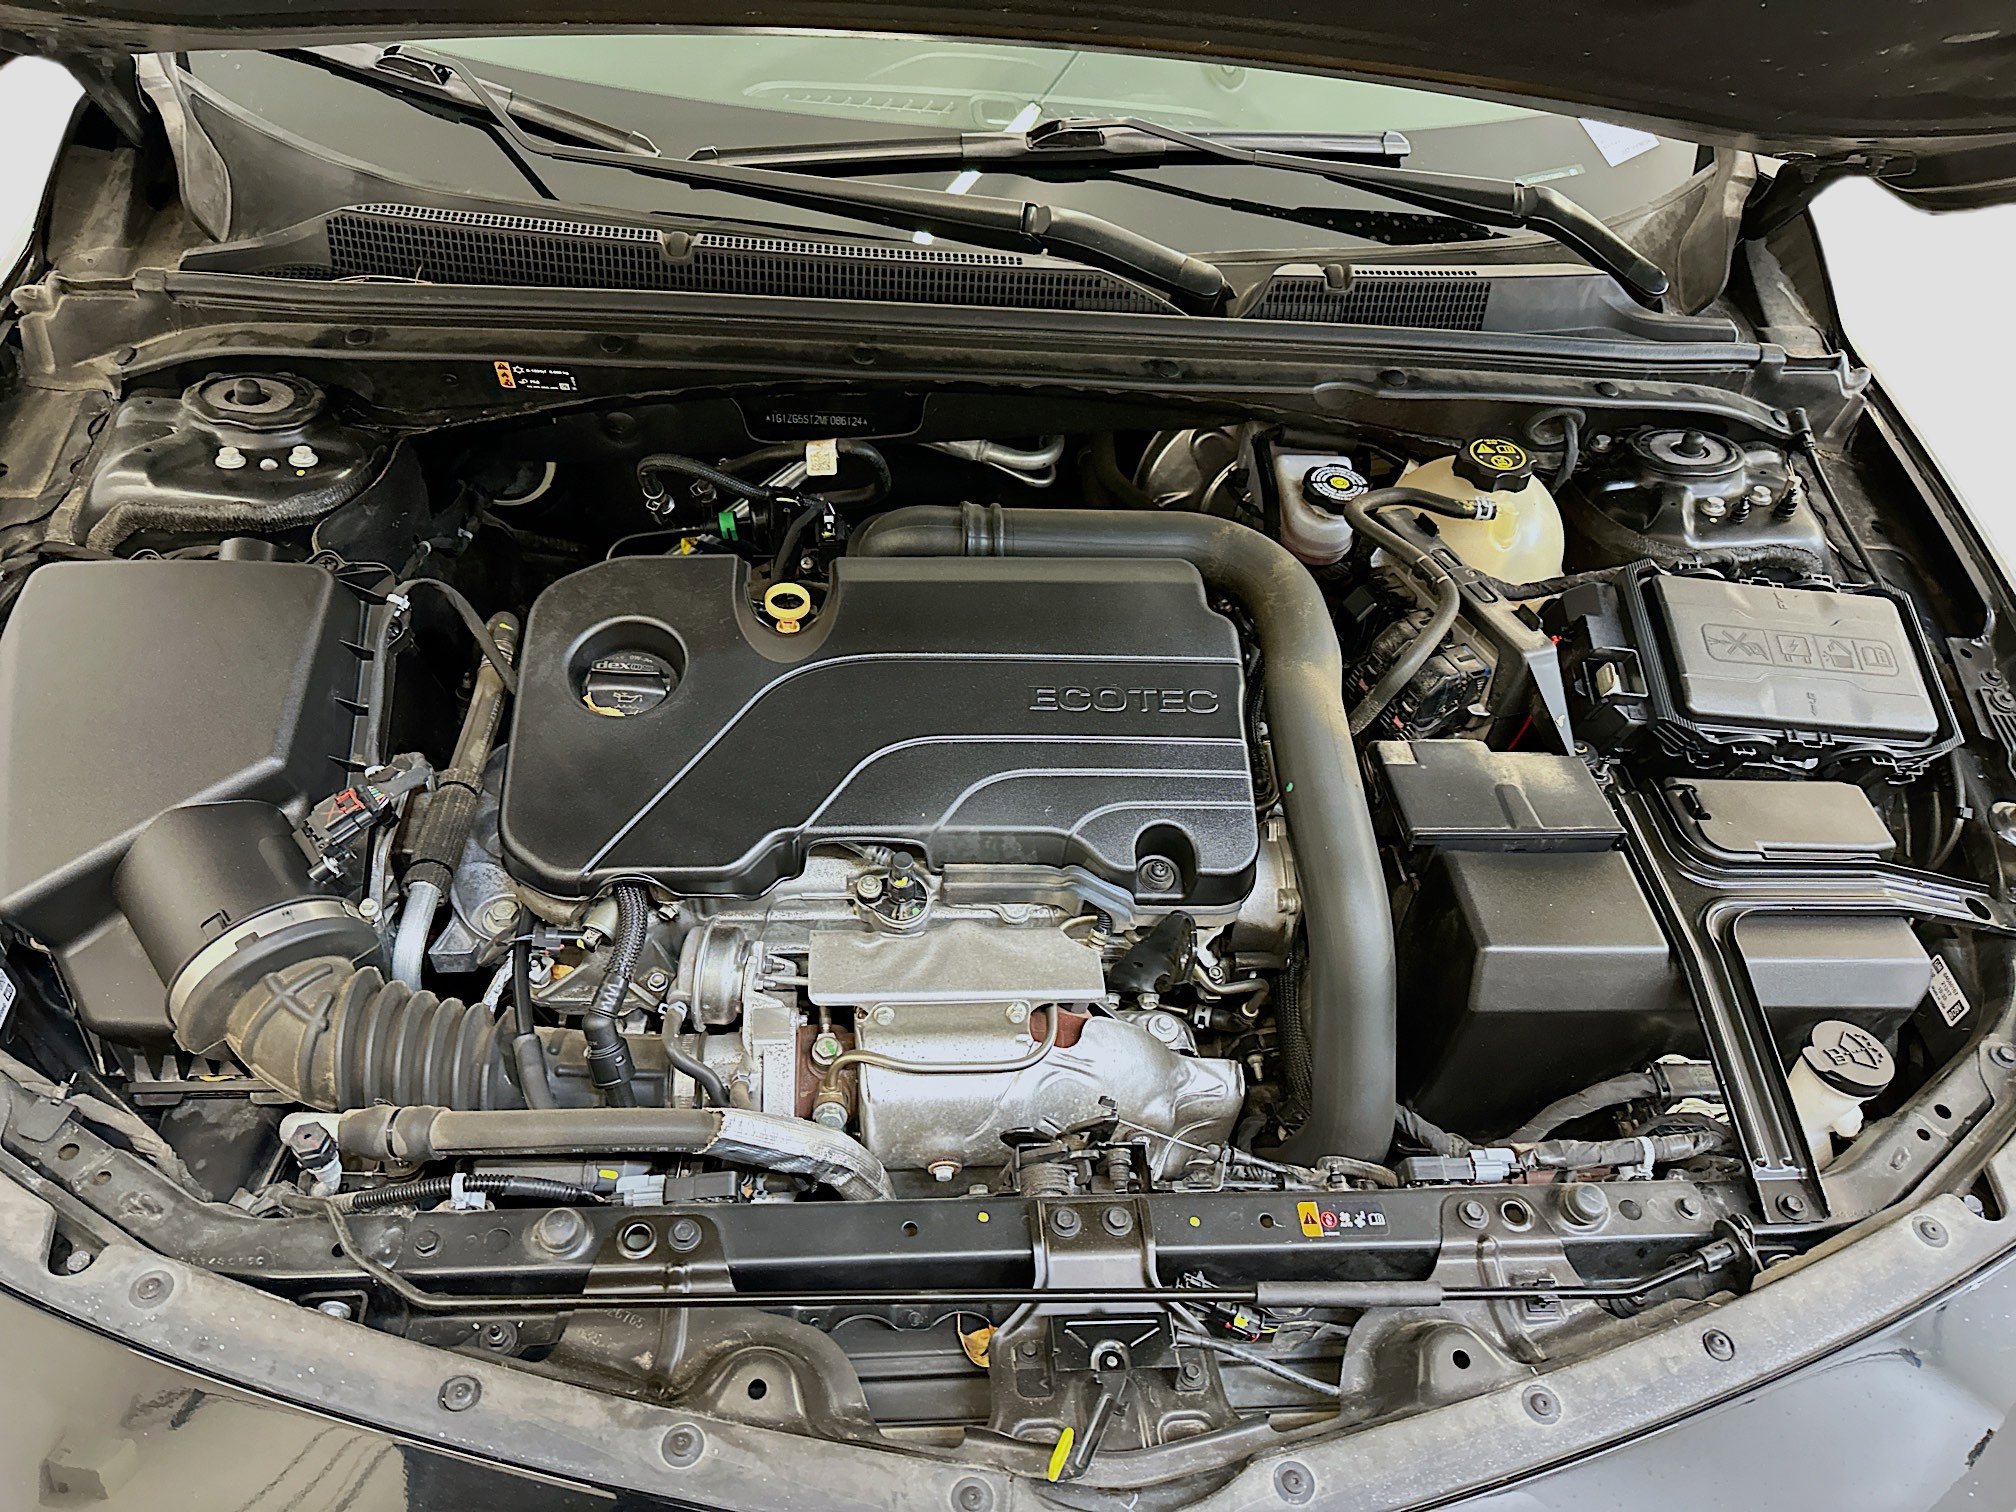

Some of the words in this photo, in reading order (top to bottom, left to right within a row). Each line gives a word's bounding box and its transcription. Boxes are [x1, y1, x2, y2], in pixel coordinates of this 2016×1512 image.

[595, 660, 654, 672] dexos
[1028, 685, 1220, 714] ECOTEC
[604, 1309, 646, 1329] 26765
